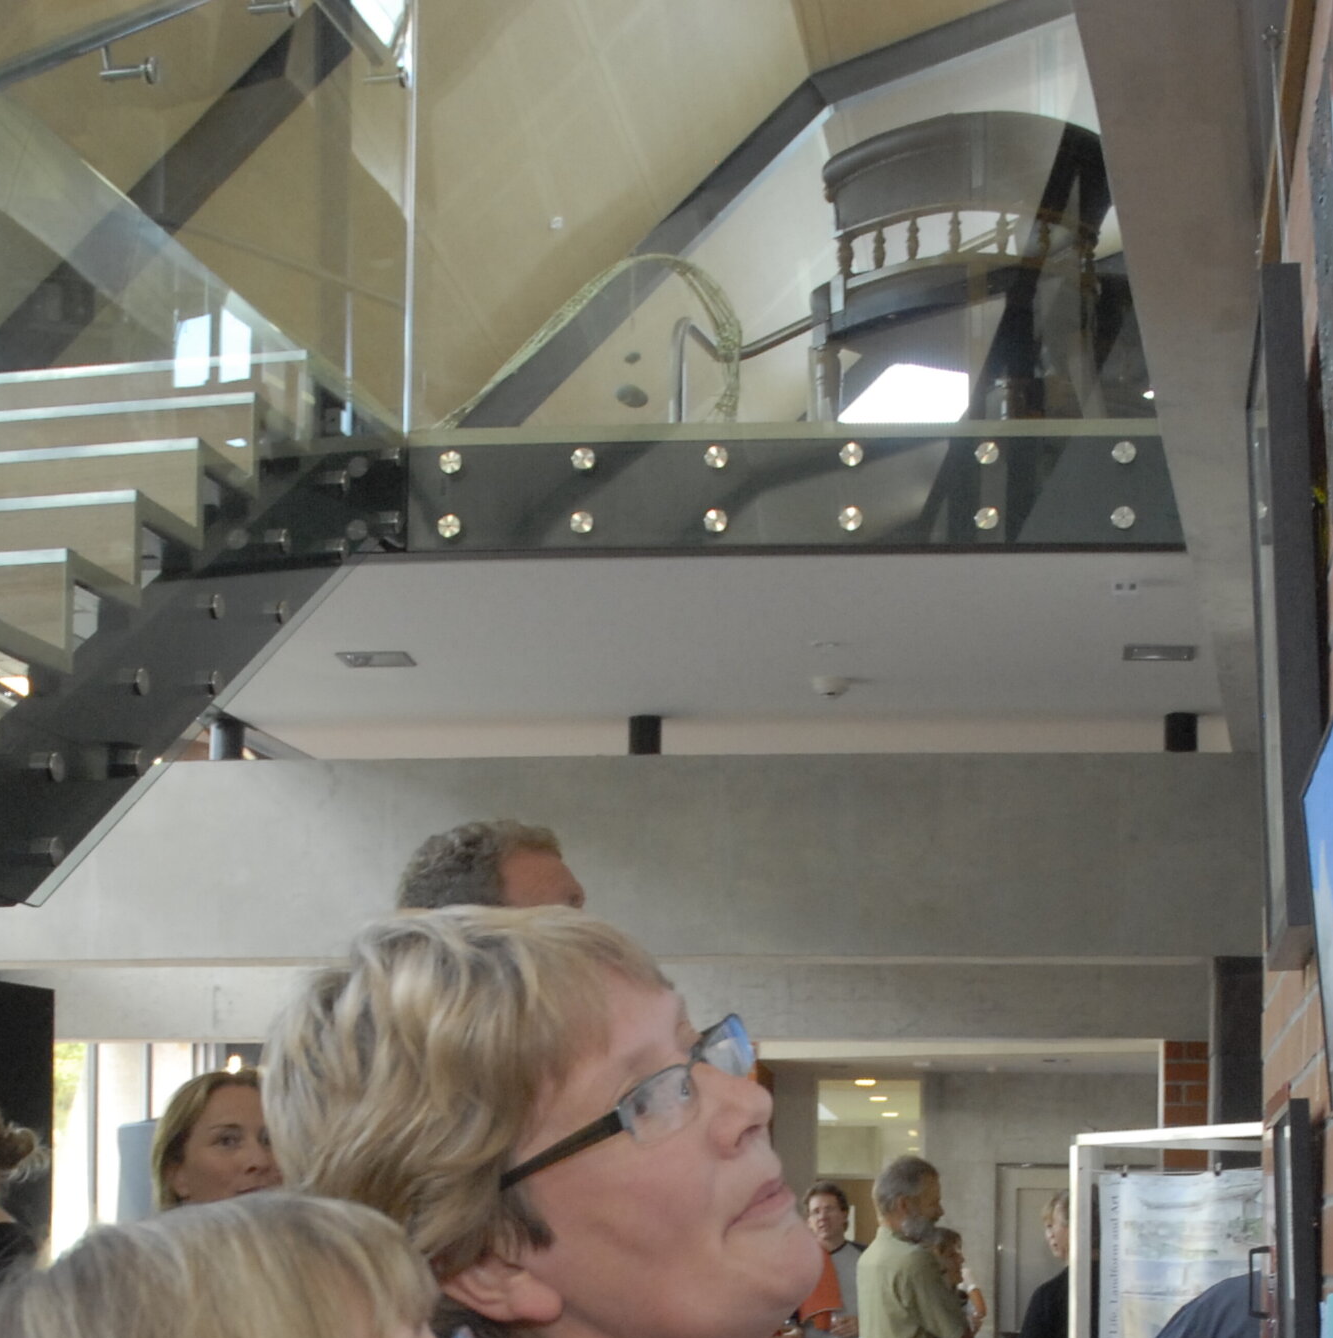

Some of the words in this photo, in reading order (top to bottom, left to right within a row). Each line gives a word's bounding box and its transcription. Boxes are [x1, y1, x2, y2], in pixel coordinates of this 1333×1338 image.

[1110, 1195, 1119, 1215] Art
[1109, 1217, 1119, 1240] and
[1109, 1242, 1119, 1304] Landform
